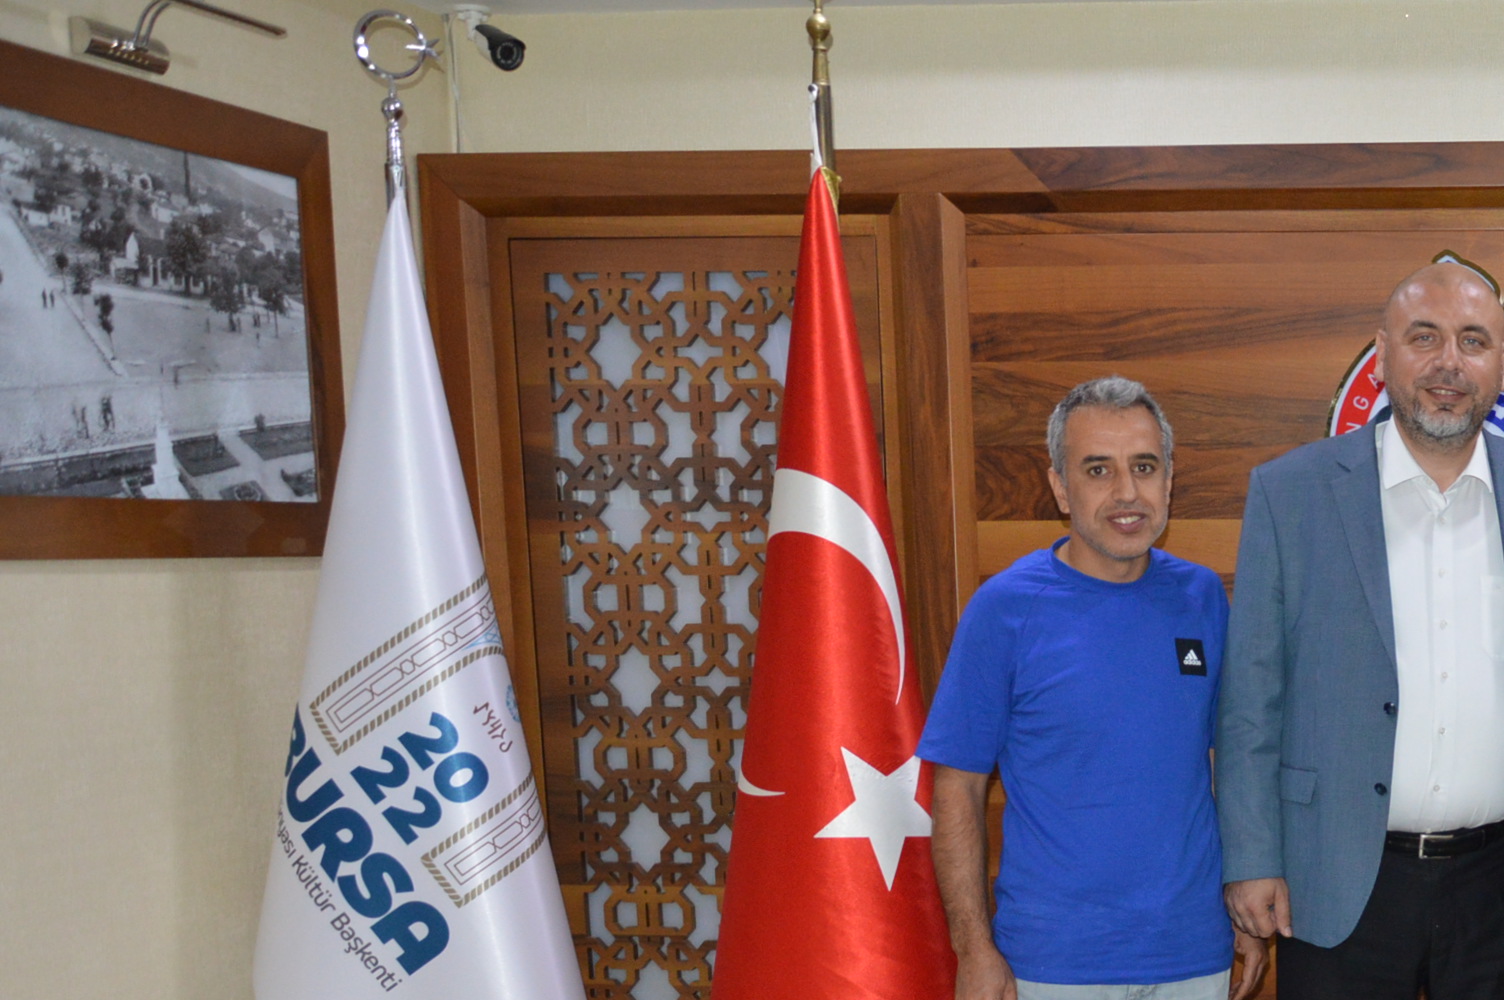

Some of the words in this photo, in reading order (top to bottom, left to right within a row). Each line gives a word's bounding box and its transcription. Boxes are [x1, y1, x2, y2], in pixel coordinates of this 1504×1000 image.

[350, 746, 444, 845] 22
[397, 712, 490, 804] 20
[291, 854, 336, 913] Kültür
[330, 911, 404, 993] Başkenti
